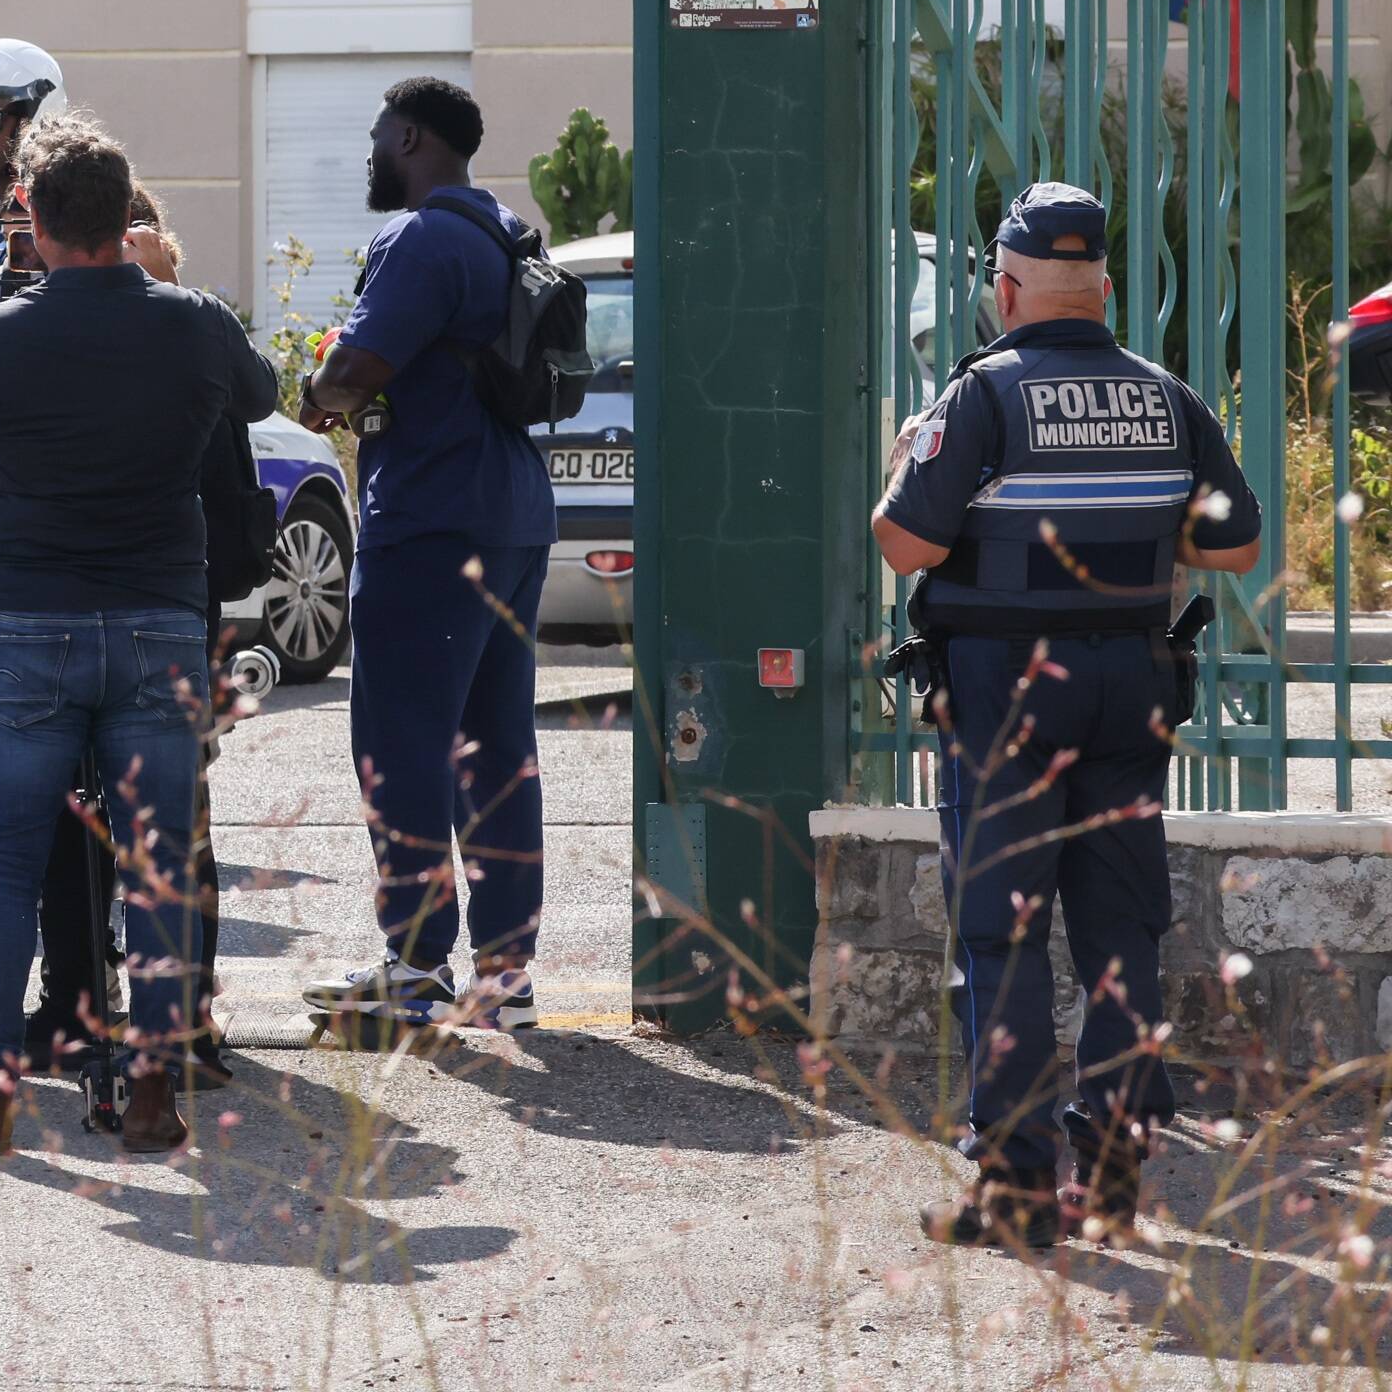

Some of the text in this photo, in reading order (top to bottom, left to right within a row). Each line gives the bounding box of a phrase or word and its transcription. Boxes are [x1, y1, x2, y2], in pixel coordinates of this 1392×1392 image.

[693, 14, 721, 22] Refuges
[1028, 382, 1167, 419] POLICE
[1037, 422, 1170, 446] MUNICIPALE
